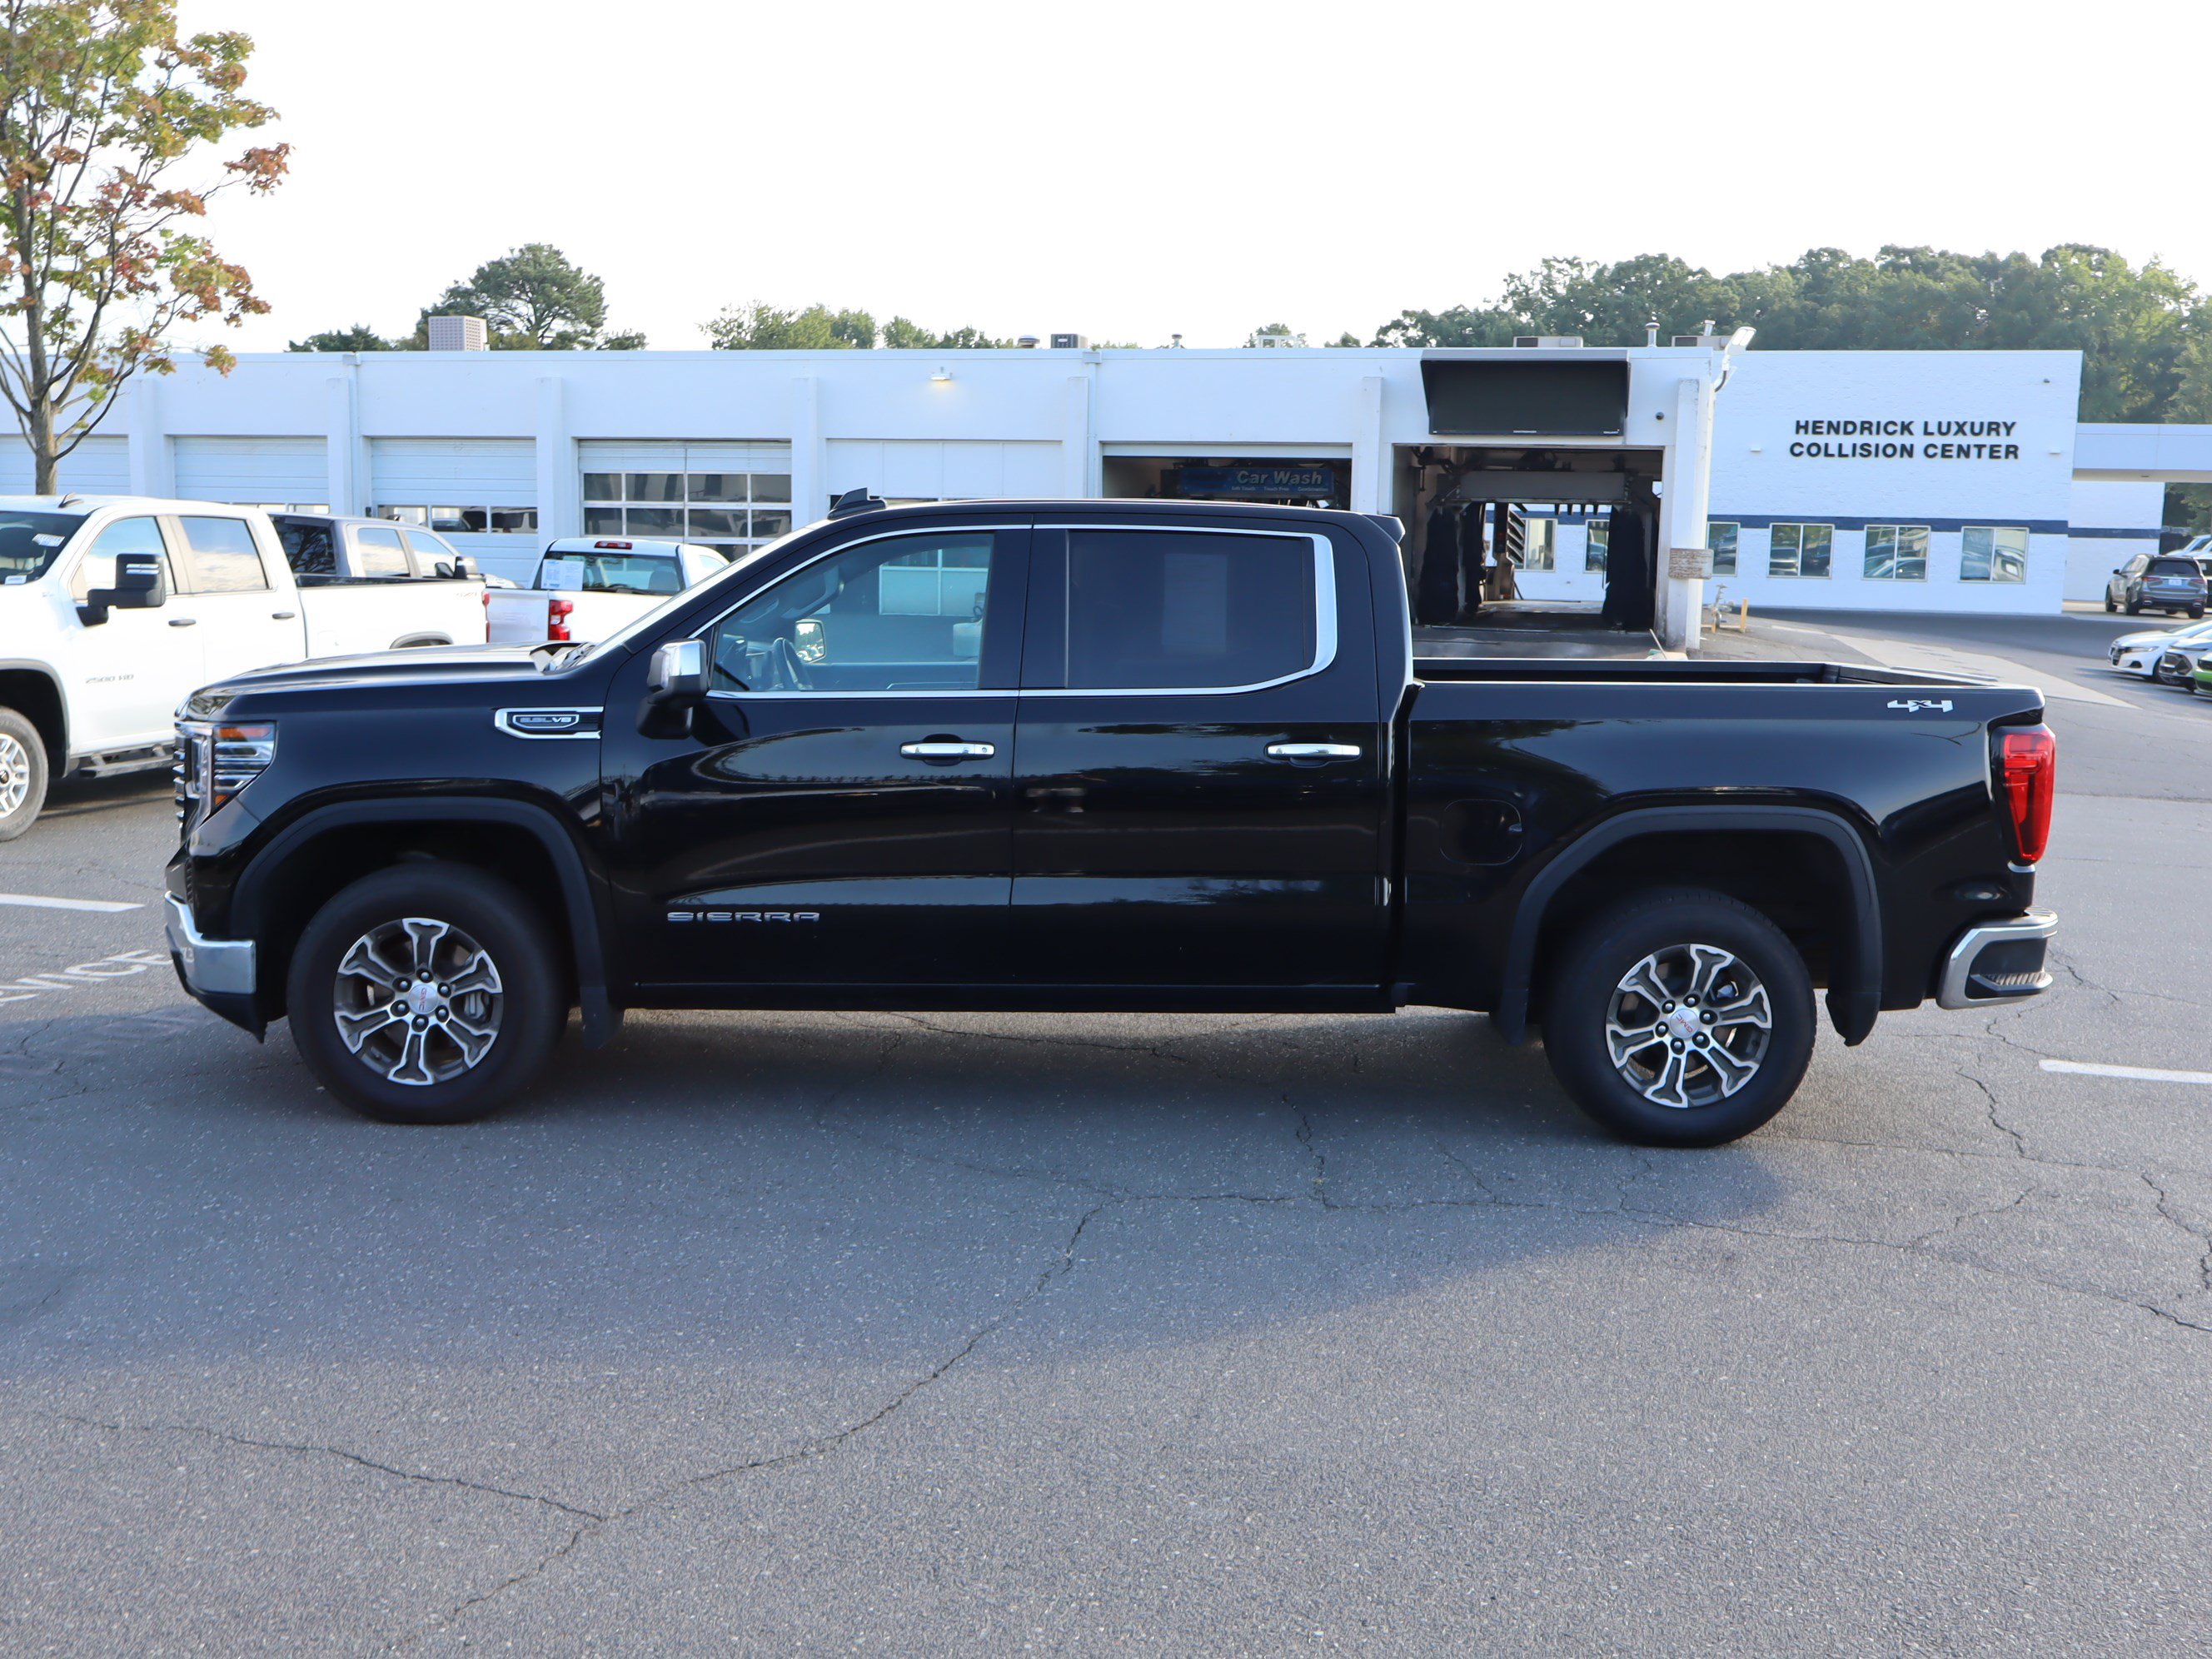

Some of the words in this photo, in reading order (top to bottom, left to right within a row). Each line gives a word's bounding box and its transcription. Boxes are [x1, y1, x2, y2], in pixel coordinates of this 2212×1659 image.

[1794, 420, 1915, 436] HENDRICK
[1923, 421, 2017, 437] LUXURY
[1789, 442, 1915, 459] COLLISION
[1923, 443, 2020, 460] CENTER
[1236, 470, 1268, 485] Car
[1273, 470, 1323, 485] Wash
[667, 912, 820, 923] SIERRA
[418, 986, 427, 1012] GMC
[1675, 1013, 1693, 1034] GMC
